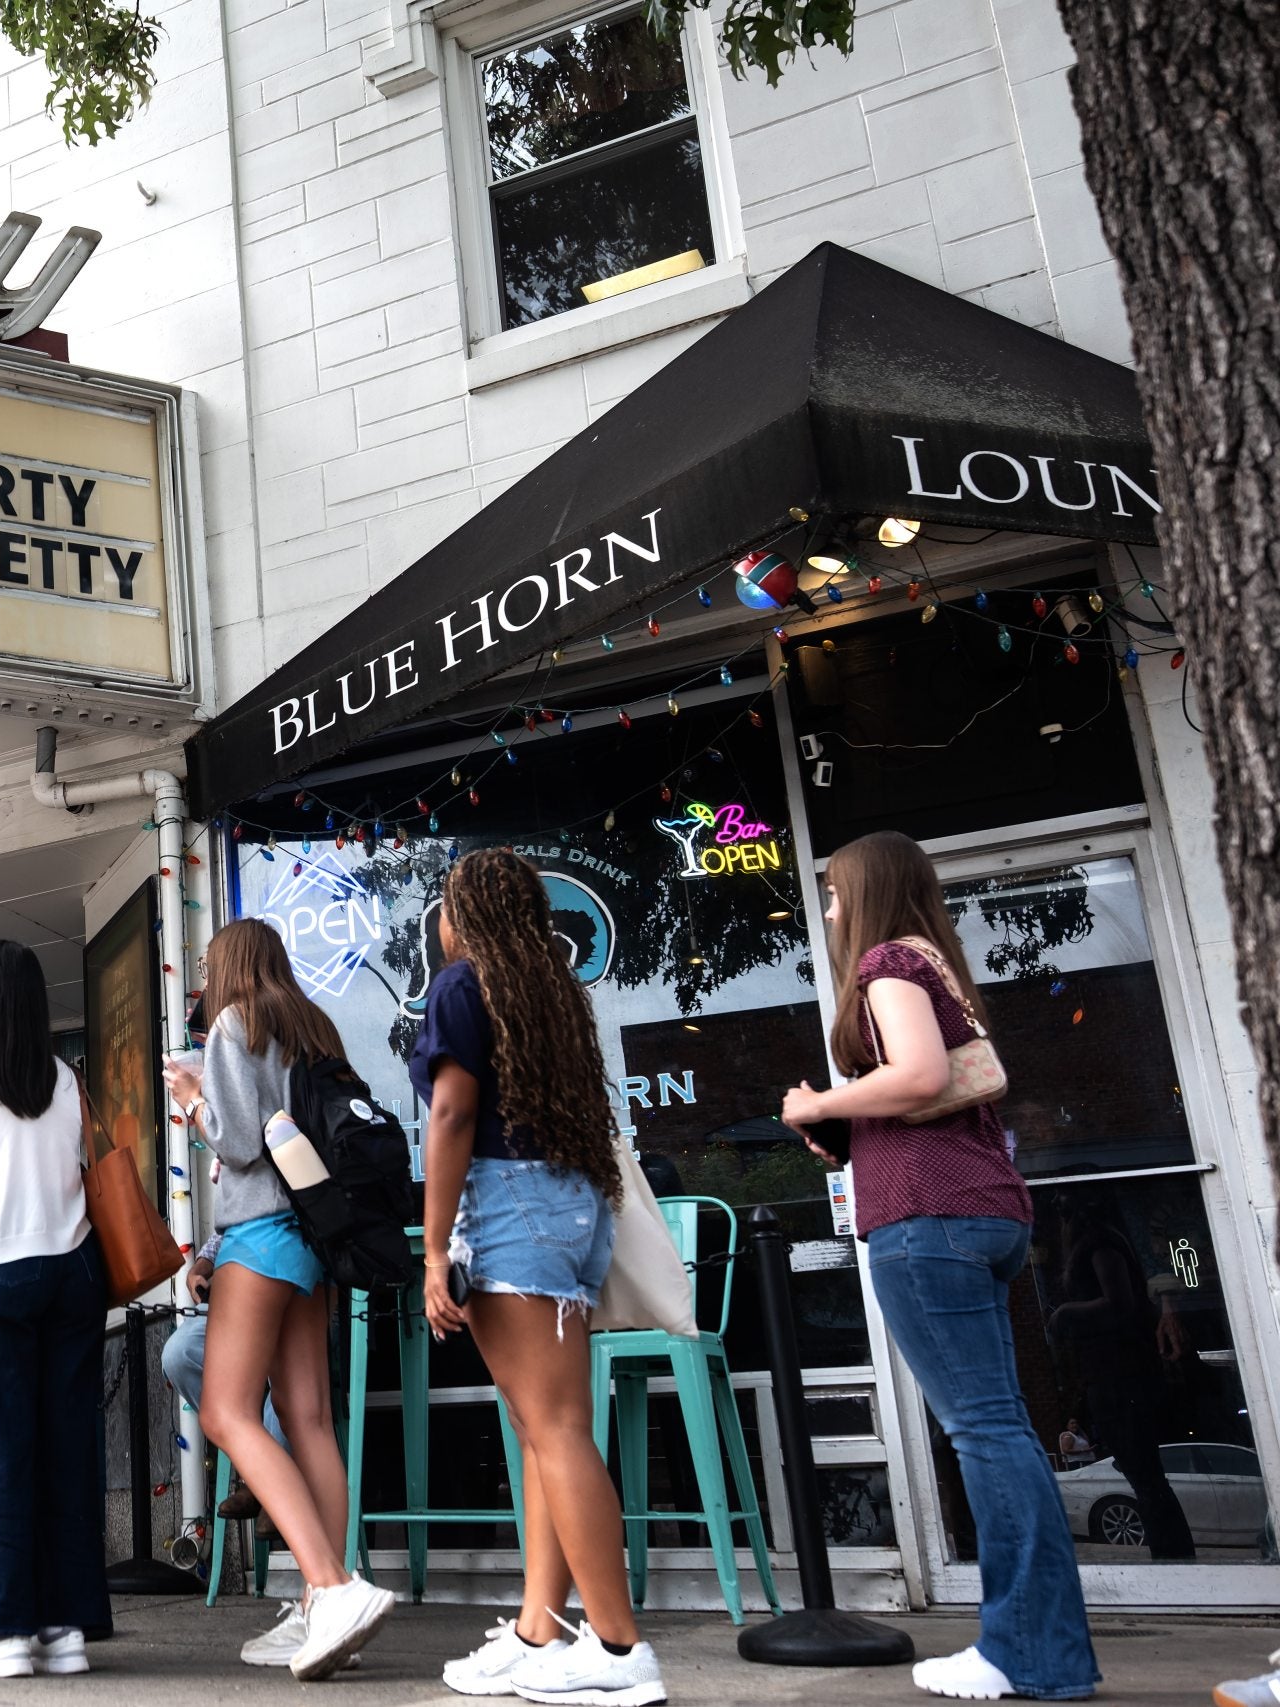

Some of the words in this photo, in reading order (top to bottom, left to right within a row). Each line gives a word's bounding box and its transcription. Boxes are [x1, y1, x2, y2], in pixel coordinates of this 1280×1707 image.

[891, 434, 1162, 518] LOUN
[267, 640, 419, 755] BLUE
[435, 508, 662, 673] HORN
[715, 803, 773, 843] Bar
[567, 848, 632, 886] DRINK
[701, 840, 781, 874] OPEN
[254, 895, 382, 953] OPEN
[605, 1070, 697, 1110] RN
